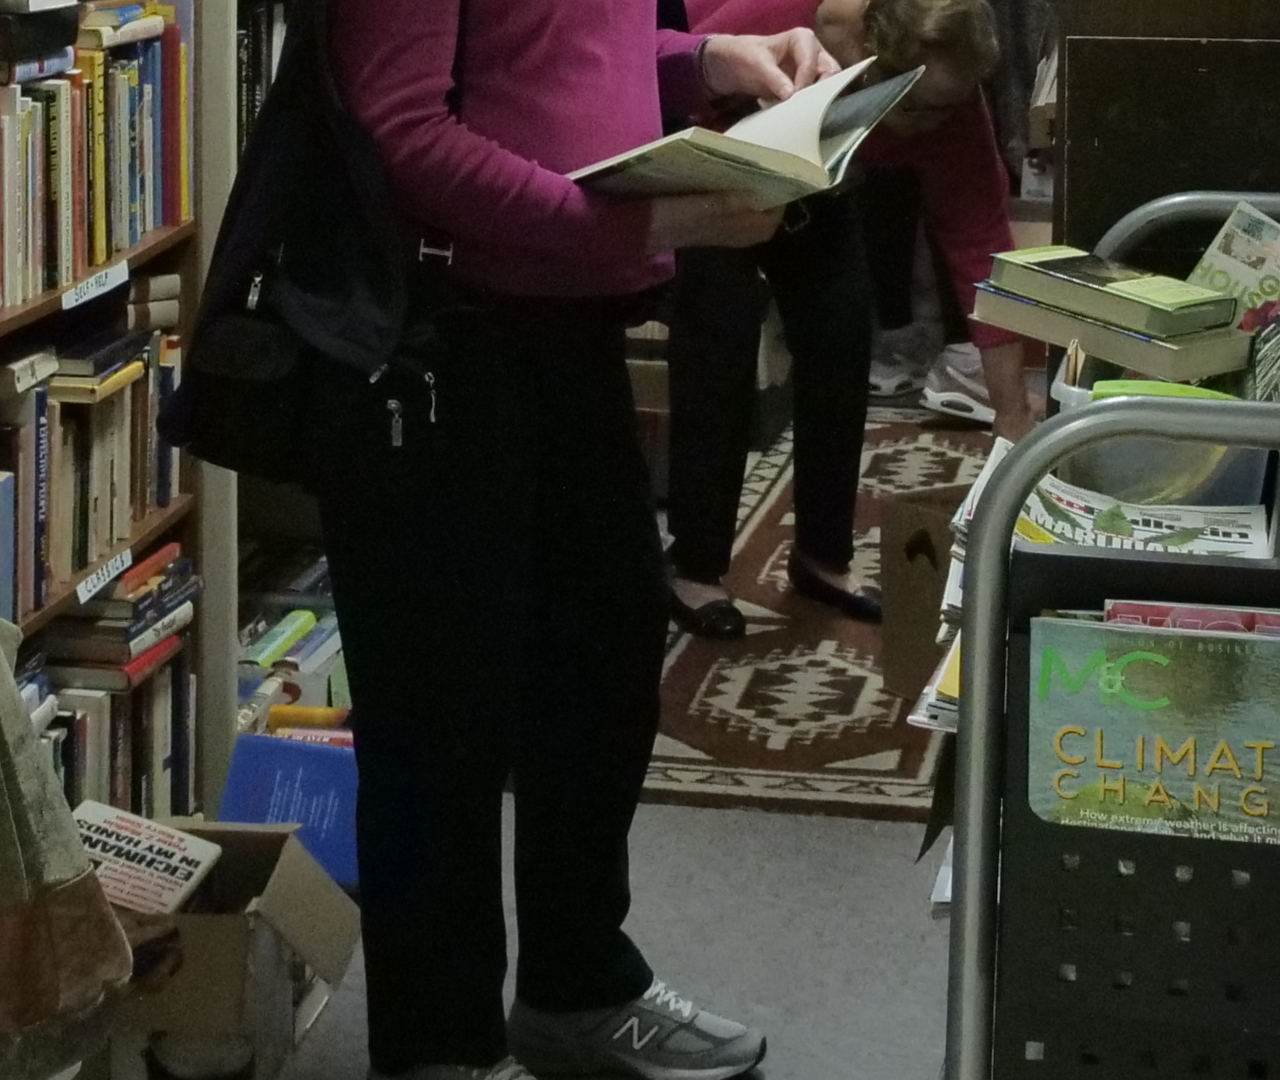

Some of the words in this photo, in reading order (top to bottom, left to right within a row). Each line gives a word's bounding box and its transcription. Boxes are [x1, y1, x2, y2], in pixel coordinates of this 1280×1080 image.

[1028, 504, 1208, 556] MARIJUA
[75, 818, 142, 849] HANDS
[1080, 808, 1109, 821] How
[1165, 817, 1218, 831] weather
[1218, 821, 1229, 832] is
[78, 833, 195, 883] EICHMAN
[142, 843, 176, 861] MY
[179, 855, 202, 870] IN
[612, 1016, 659, 1051] N
